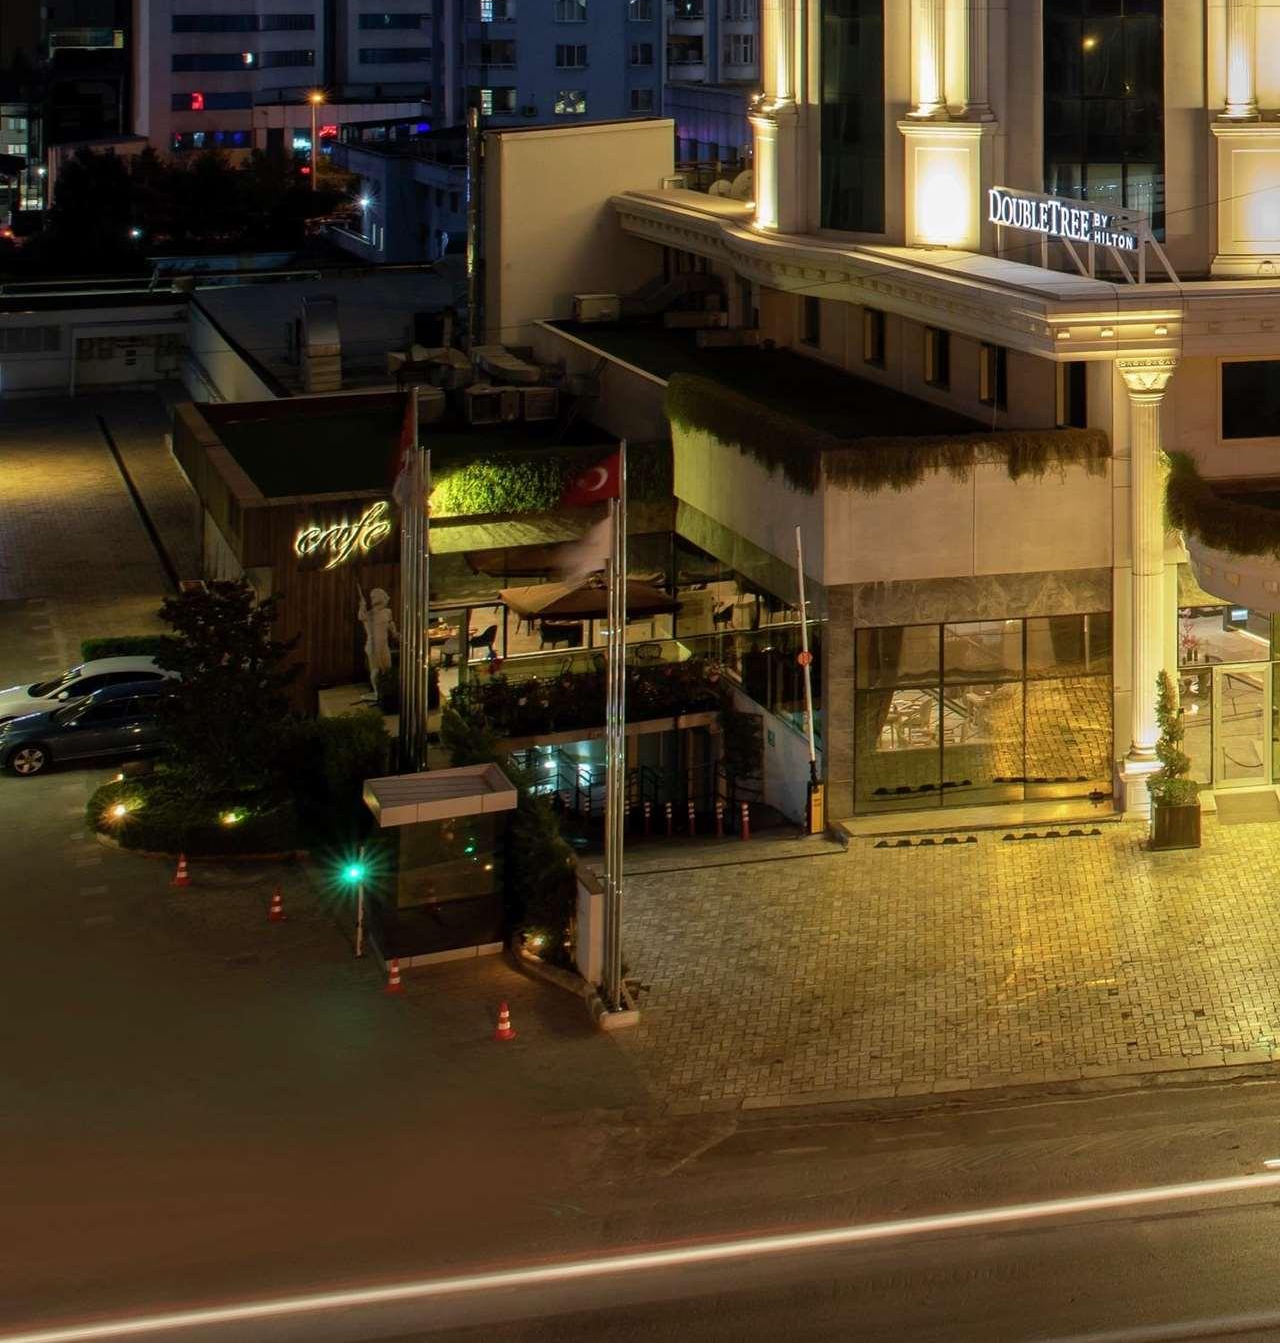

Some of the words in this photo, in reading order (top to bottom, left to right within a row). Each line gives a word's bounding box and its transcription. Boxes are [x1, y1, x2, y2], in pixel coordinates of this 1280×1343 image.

[1093, 214, 1109, 228] BY
[1093, 230, 1134, 250] HILTON
[295, 501, 391, 570] cafe
